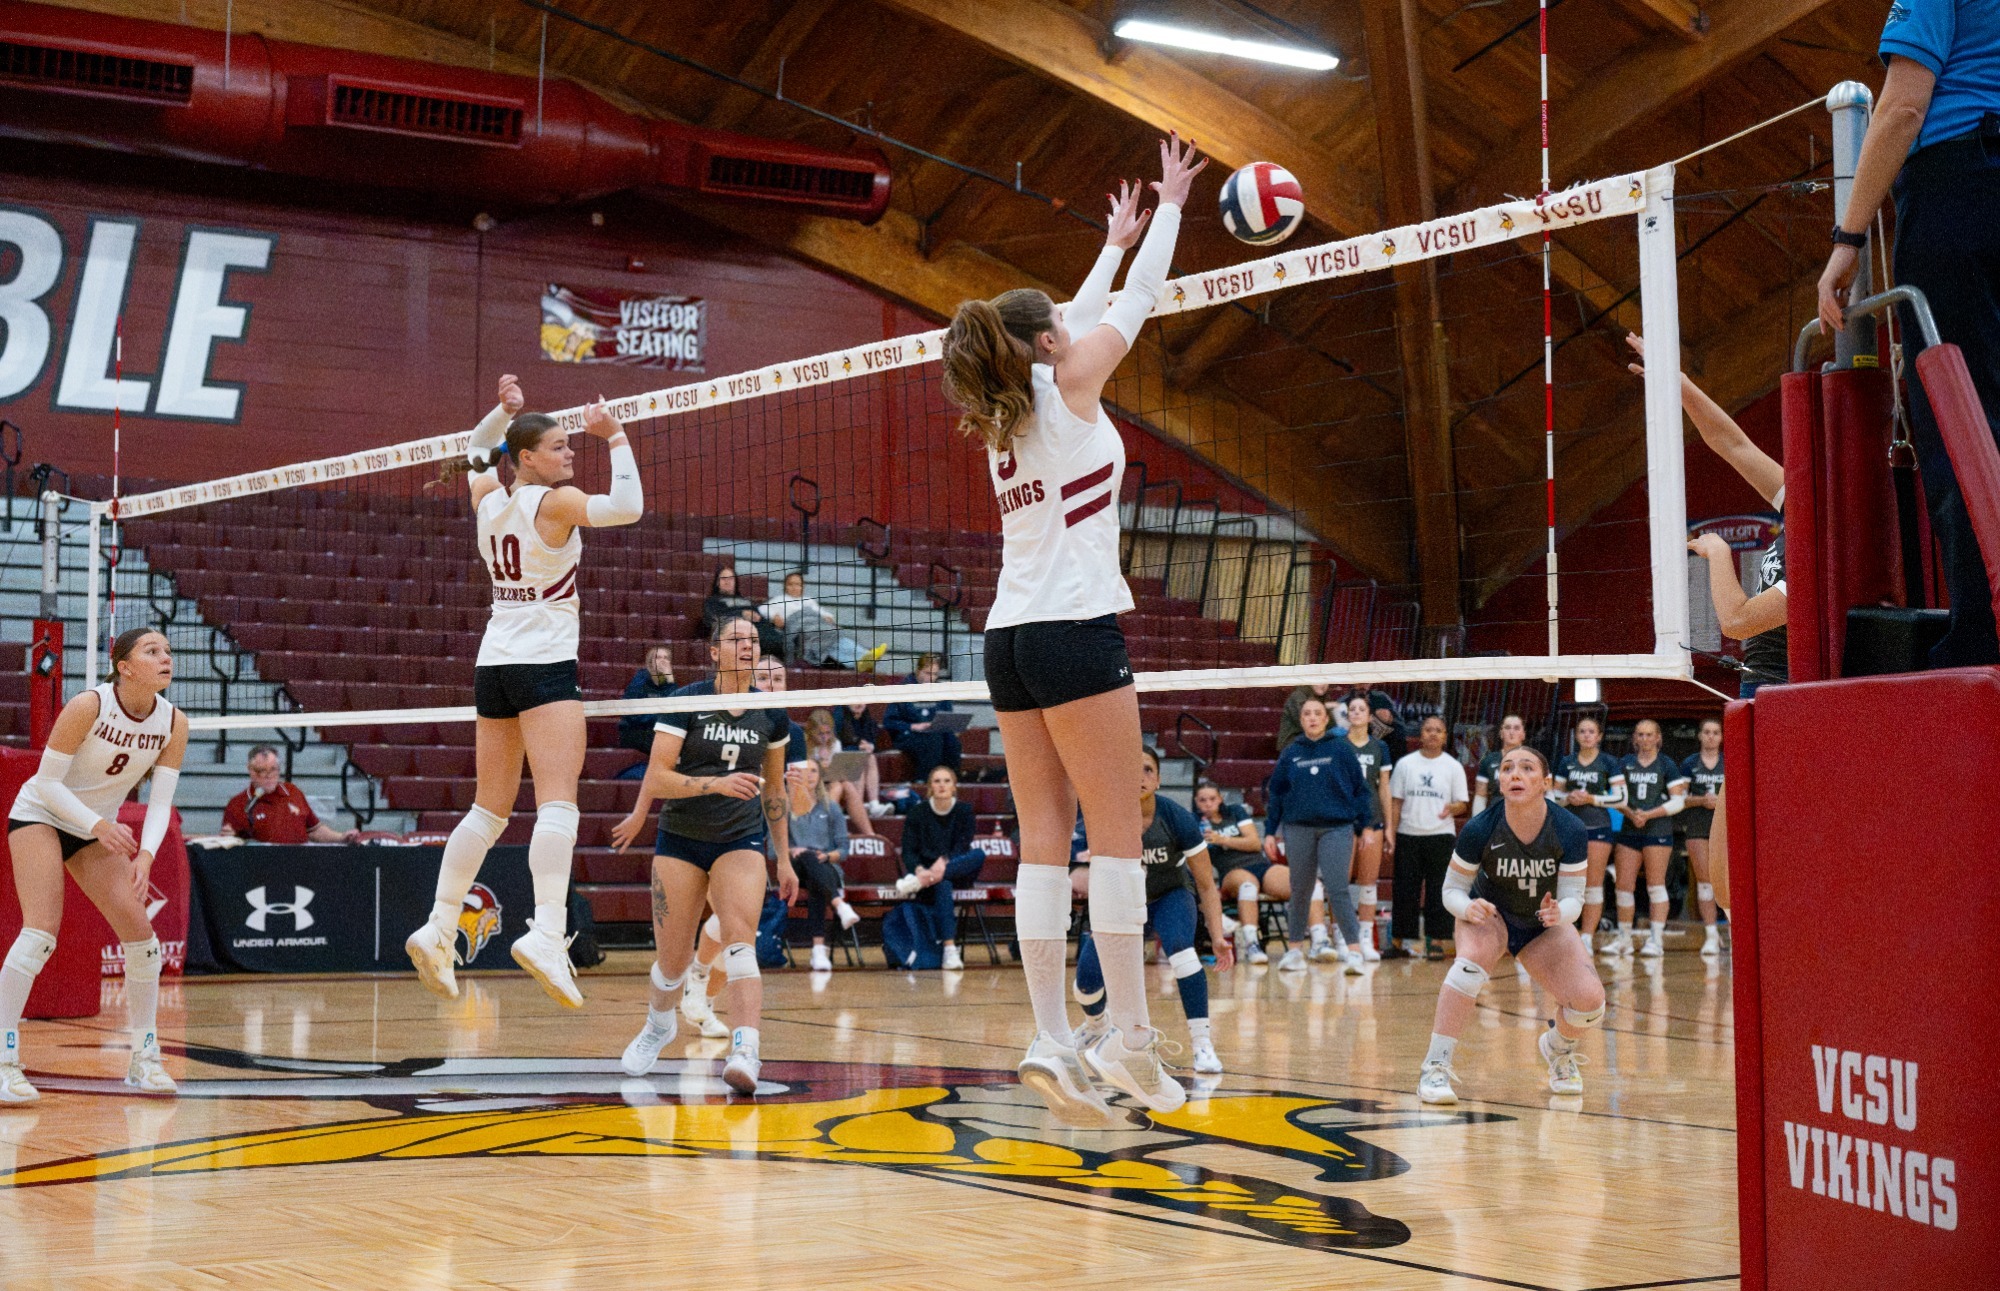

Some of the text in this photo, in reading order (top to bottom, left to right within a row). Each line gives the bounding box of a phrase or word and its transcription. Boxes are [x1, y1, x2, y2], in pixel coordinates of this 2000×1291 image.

[1532, 190, 1603, 224] VCSU
[1416, 220, 1477, 253] VCSU
[1305, 245, 1361, 277] VCSU
[1203, 269, 1255, 300] VCSU
[620, 300, 699, 330] VISITOR
[616, 330, 698, 360] SEATING
[862, 345, 903, 369] VCSU
[792, 361, 830, 384] VCSU
[728, 375, 762, 397] VCSU
[666, 389, 699, 409] VCSU
[364, 454, 389, 470] VCSU
[408, 444, 433, 462] VCSU
[284, 468, 306, 485] VCSU
[324, 464, 347, 478] VCSU
[212, 483, 232, 498] VCSU
[247, 476, 268, 492] VCSU
[180, 488, 198, 504] VCSU
[999, 479, 1046, 516] KINGS
[490, 533, 522, 582] 10
[138, 733, 166, 750] CITY
[703, 722, 760, 745] HAWKS
[105, 753, 130, 776] 8
[721, 743, 741, 771] 9
[1569, 770, 1599, 784] HAWKS
[1629, 772, 1658, 785] HAWKS
[1637, 783, 1648, 800] 8
[1496, 858, 1557, 878] HAWKS
[1518, 878, 1538, 898] 4
[233, 937, 326, 948] UNDER ARMOUR
[1811, 1044, 1919, 1133] VCSU
[1783, 1120, 1959, 1232] VIKINGS
